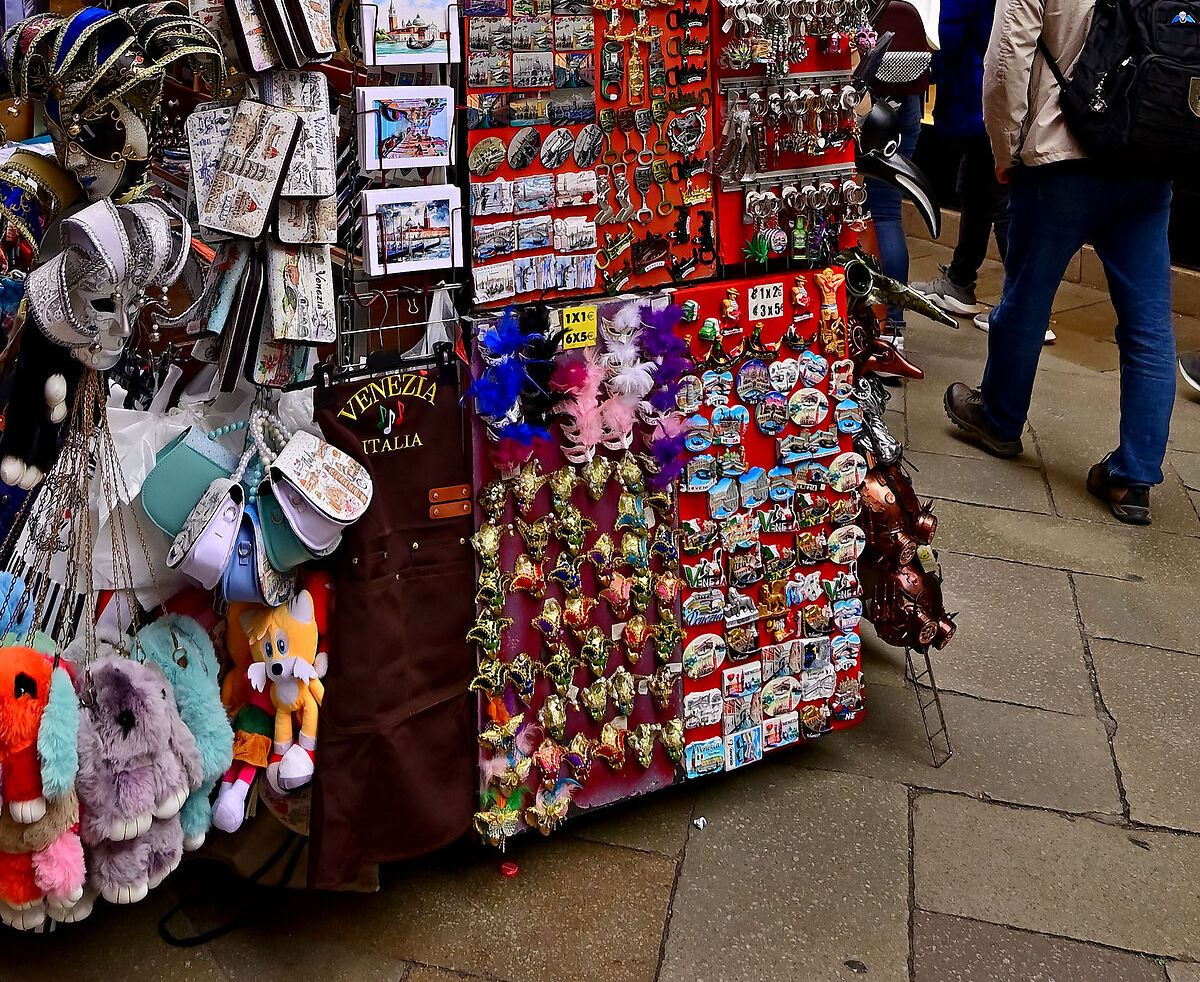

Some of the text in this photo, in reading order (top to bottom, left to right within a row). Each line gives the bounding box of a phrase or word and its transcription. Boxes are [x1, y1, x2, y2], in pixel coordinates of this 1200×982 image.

[315, 270, 326, 311] Venezia
[337, 373, 437, 421] VENEZIA
[362, 433, 423, 455] ITALIA
